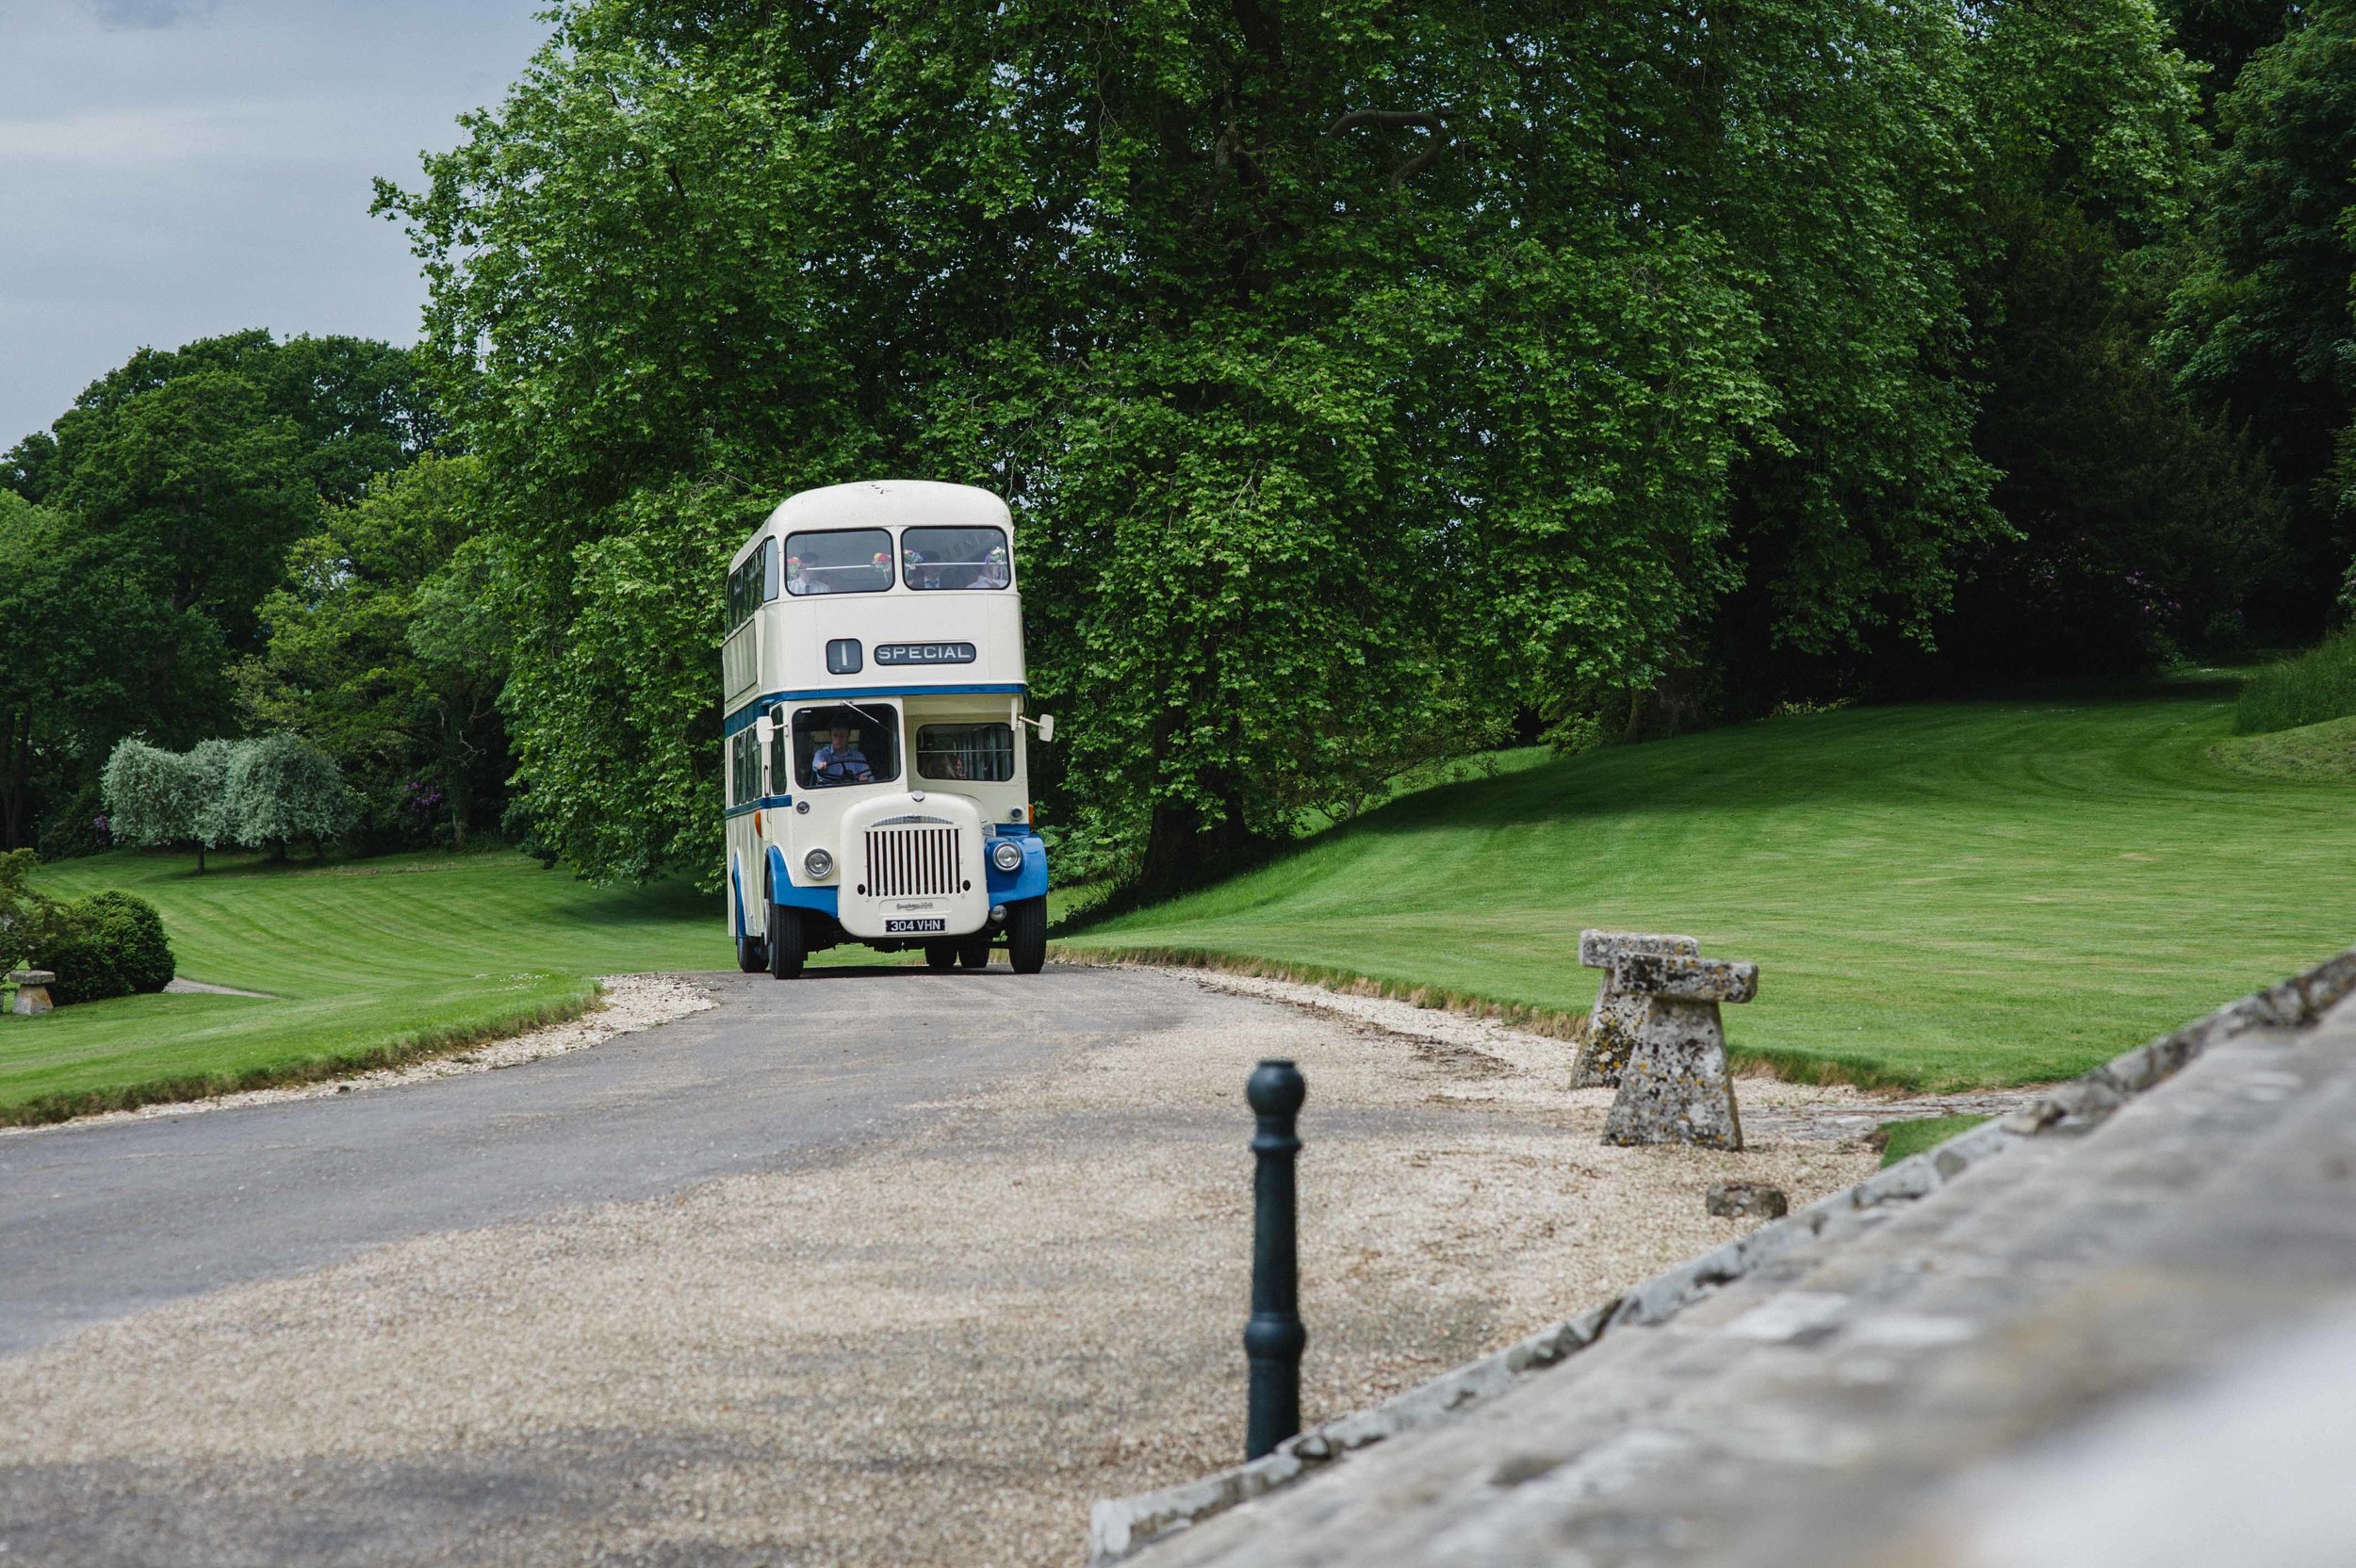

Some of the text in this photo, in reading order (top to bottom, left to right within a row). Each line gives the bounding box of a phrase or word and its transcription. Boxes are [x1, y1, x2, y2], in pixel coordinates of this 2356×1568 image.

[878, 645, 971, 660] SPECIAL
[891, 920, 941, 931] 304 VHN
